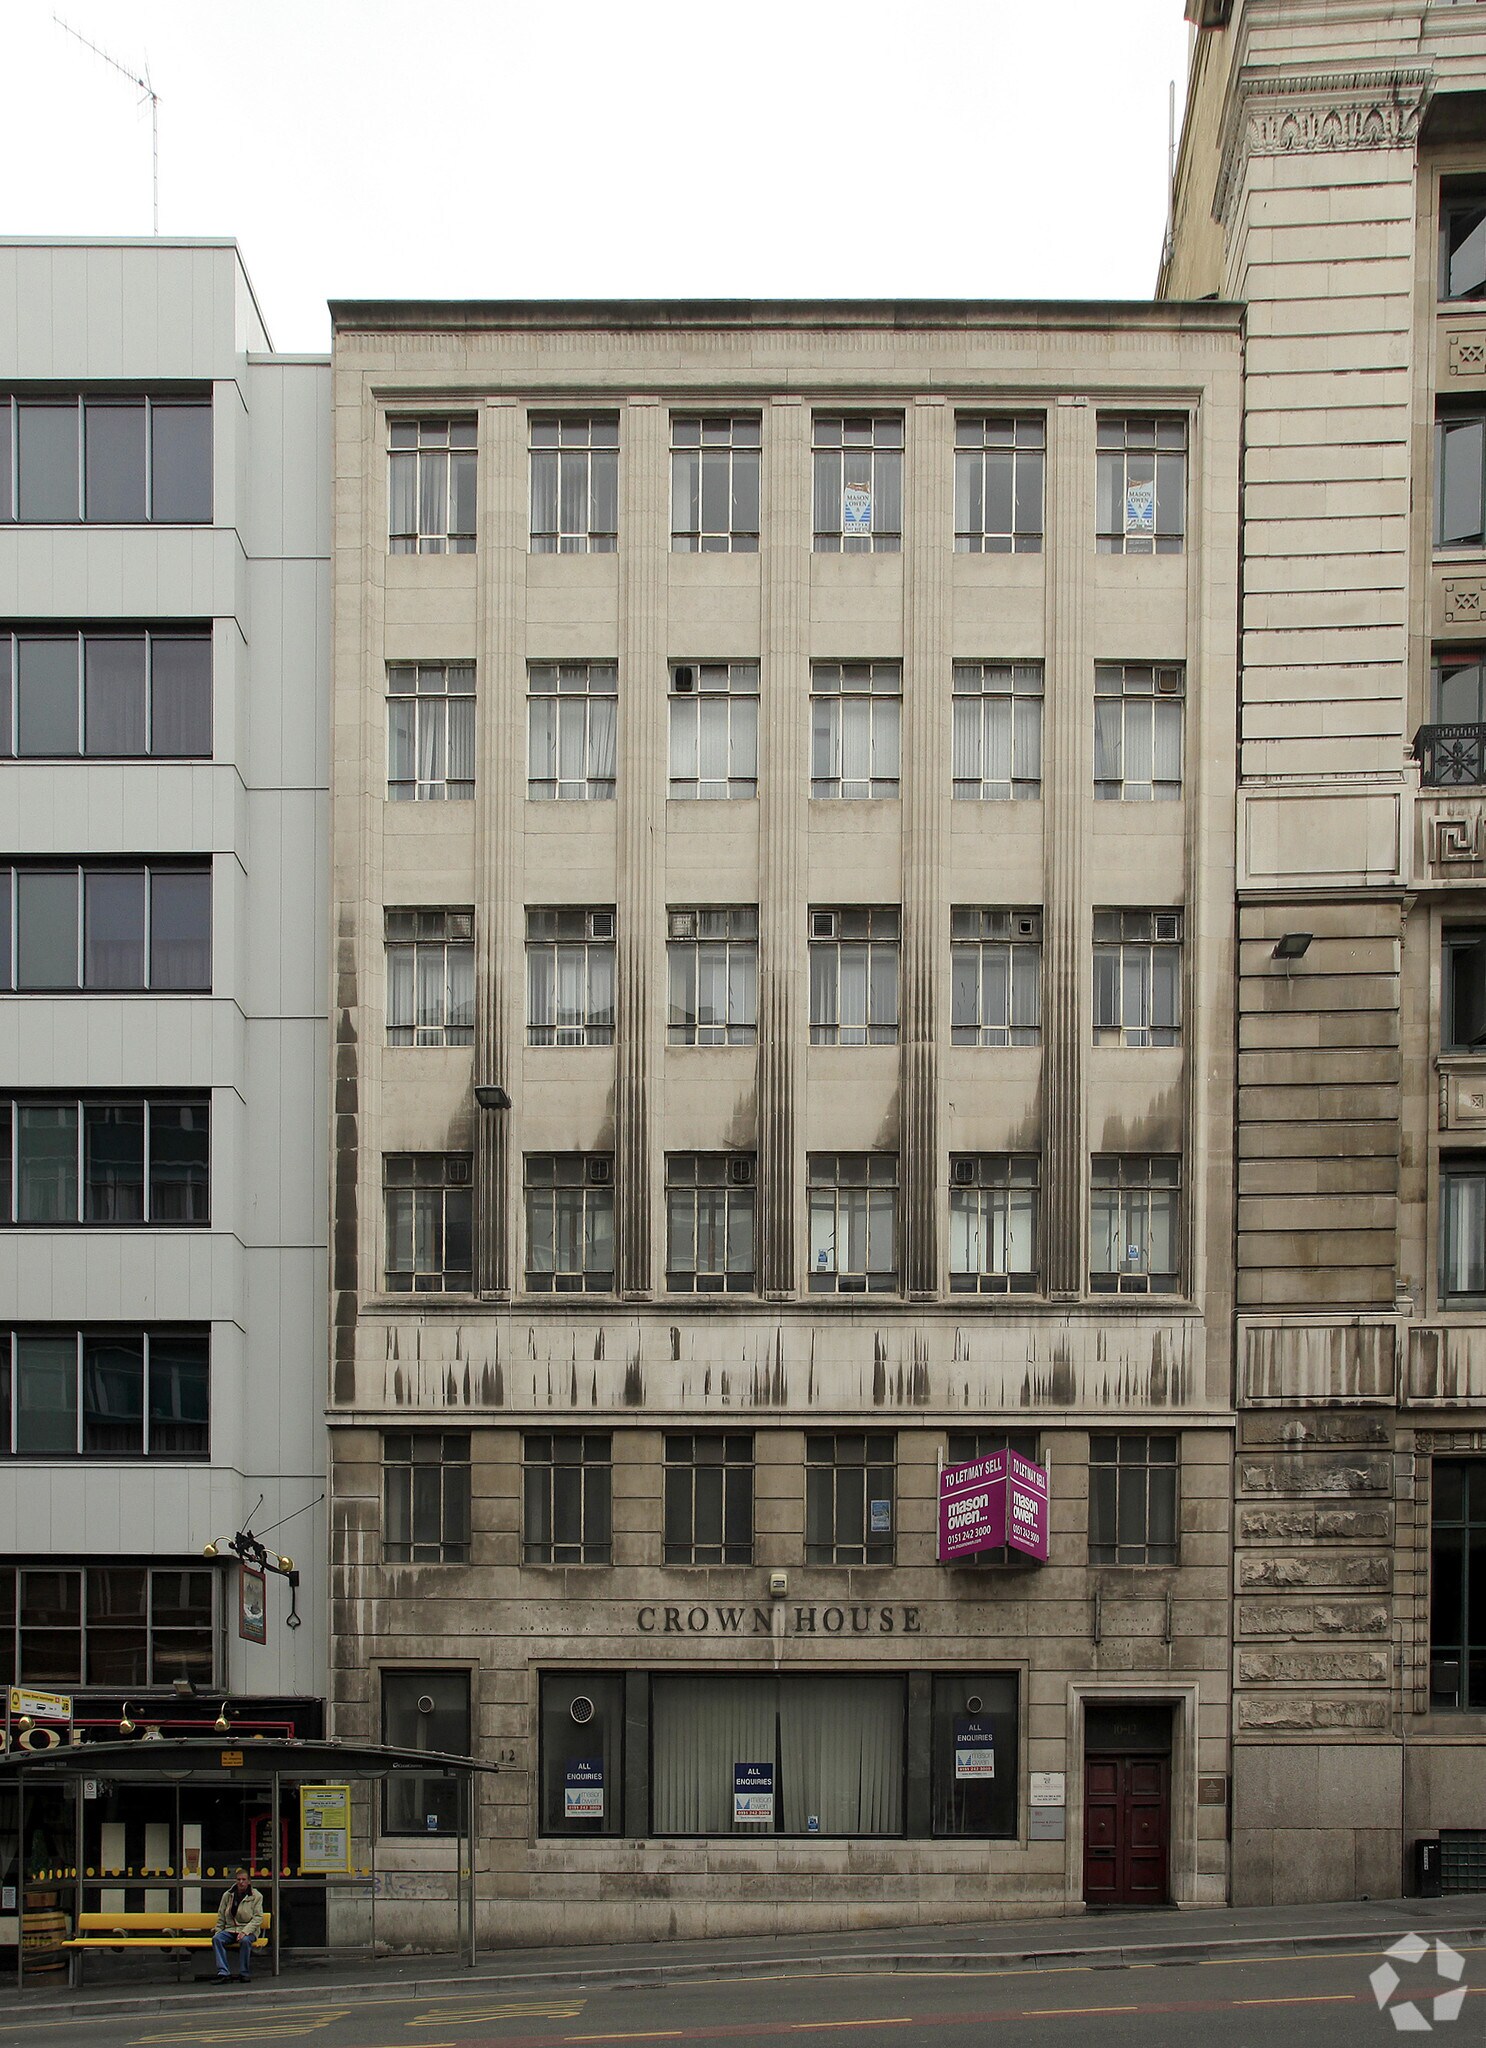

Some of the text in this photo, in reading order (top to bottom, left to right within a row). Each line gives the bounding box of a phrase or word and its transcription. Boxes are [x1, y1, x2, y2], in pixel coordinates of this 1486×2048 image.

[945, 1474, 955, 1487] TO
[985, 1457, 1002, 1475] SELL
[1013, 1458, 1020, 1473] TO
[1036, 1472, 1046, 1490] SELL
[948, 1493, 989, 1517] mason
[1013, 1490, 1038, 1515] mason
[947, 1524, 992, 1545] 0151 242 3000
[637, 1606, 921, 1632] CROWN HOUSE
[957, 1734, 993, 1742] ENQUIRIES
[566, 1772, 603, 1780] ENQUIRIES
[736, 1778, 772, 1786] ENQUIRIES
